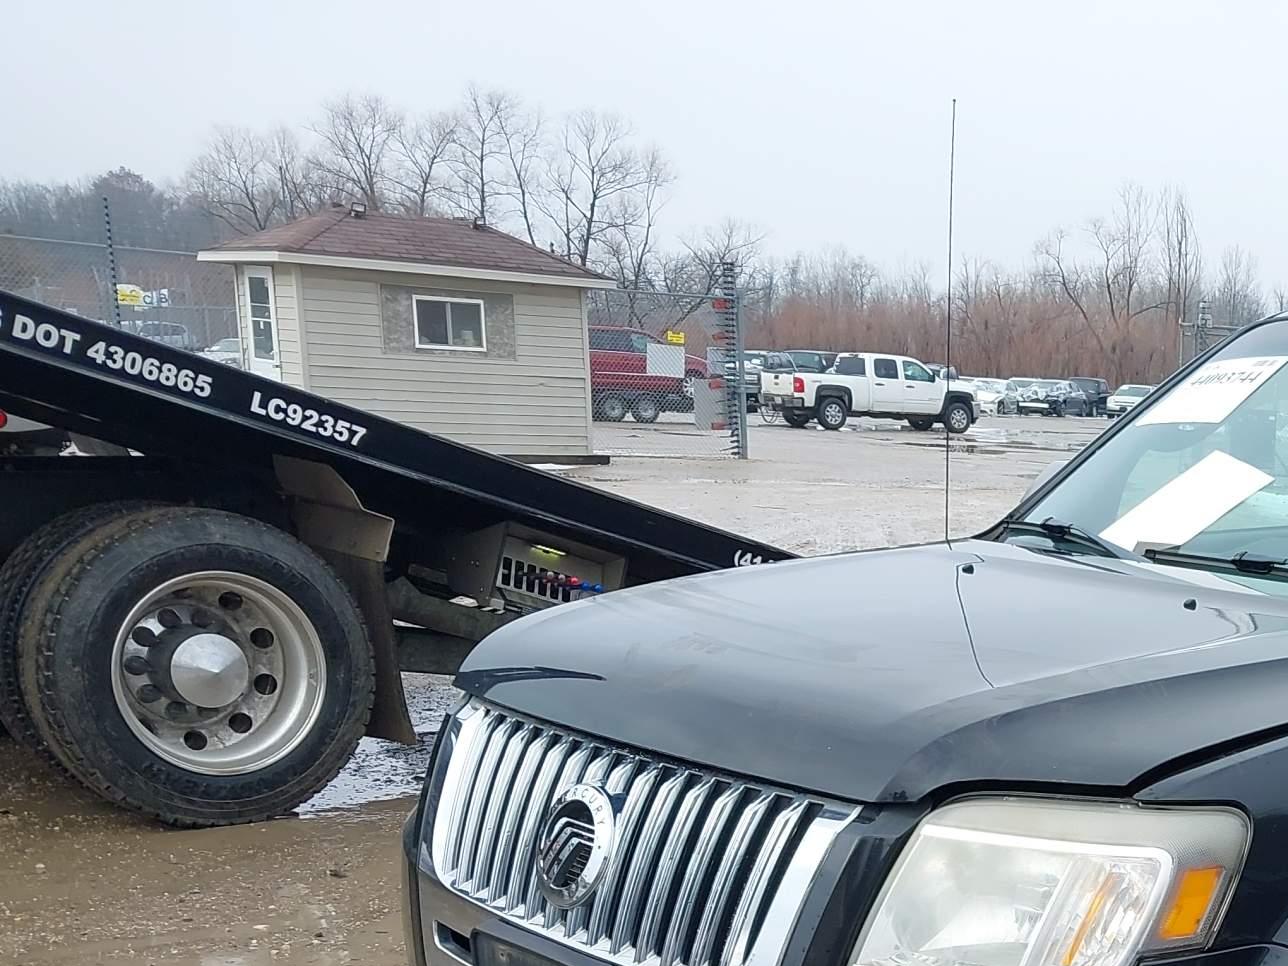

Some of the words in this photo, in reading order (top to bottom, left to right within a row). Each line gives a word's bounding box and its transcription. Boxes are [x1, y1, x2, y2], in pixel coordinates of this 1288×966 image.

[12, 314, 81, 354] DOT
[86, 341, 213, 398] 4306865
[250, 391, 367, 446] LC92357
[734, 550, 774, 566] (41
